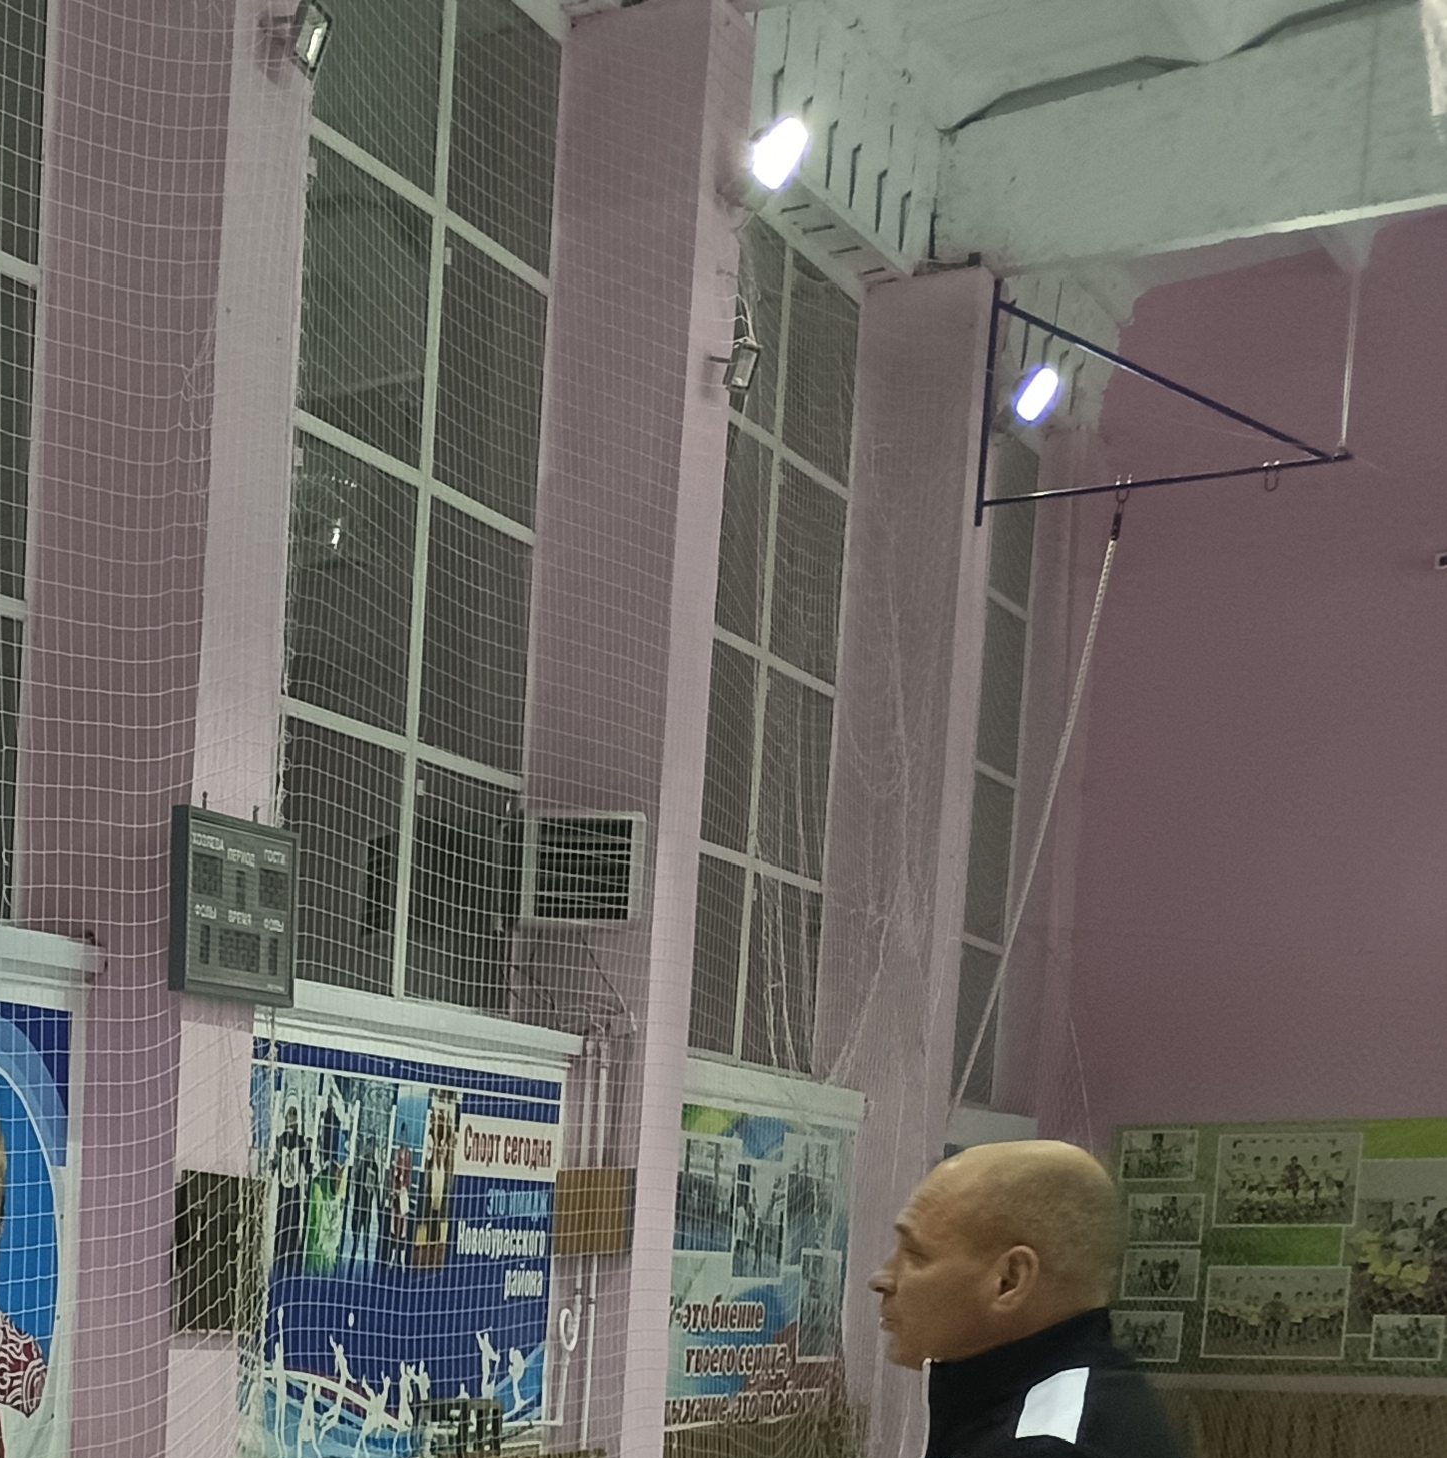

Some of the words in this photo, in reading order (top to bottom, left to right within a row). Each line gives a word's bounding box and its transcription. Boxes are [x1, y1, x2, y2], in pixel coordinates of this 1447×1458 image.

[463, 1124, 501, 1167] Спорт
[503, 1135, 552, 1171] сегодня
[456, 1220, 547, 1260] Новобурасского
[503, 1263, 543, 1300] района
[683, 1301, 709, 1331] это
[710, 1294, 764, 1331] биение
[685, 1346, 737, 1375] твоего
